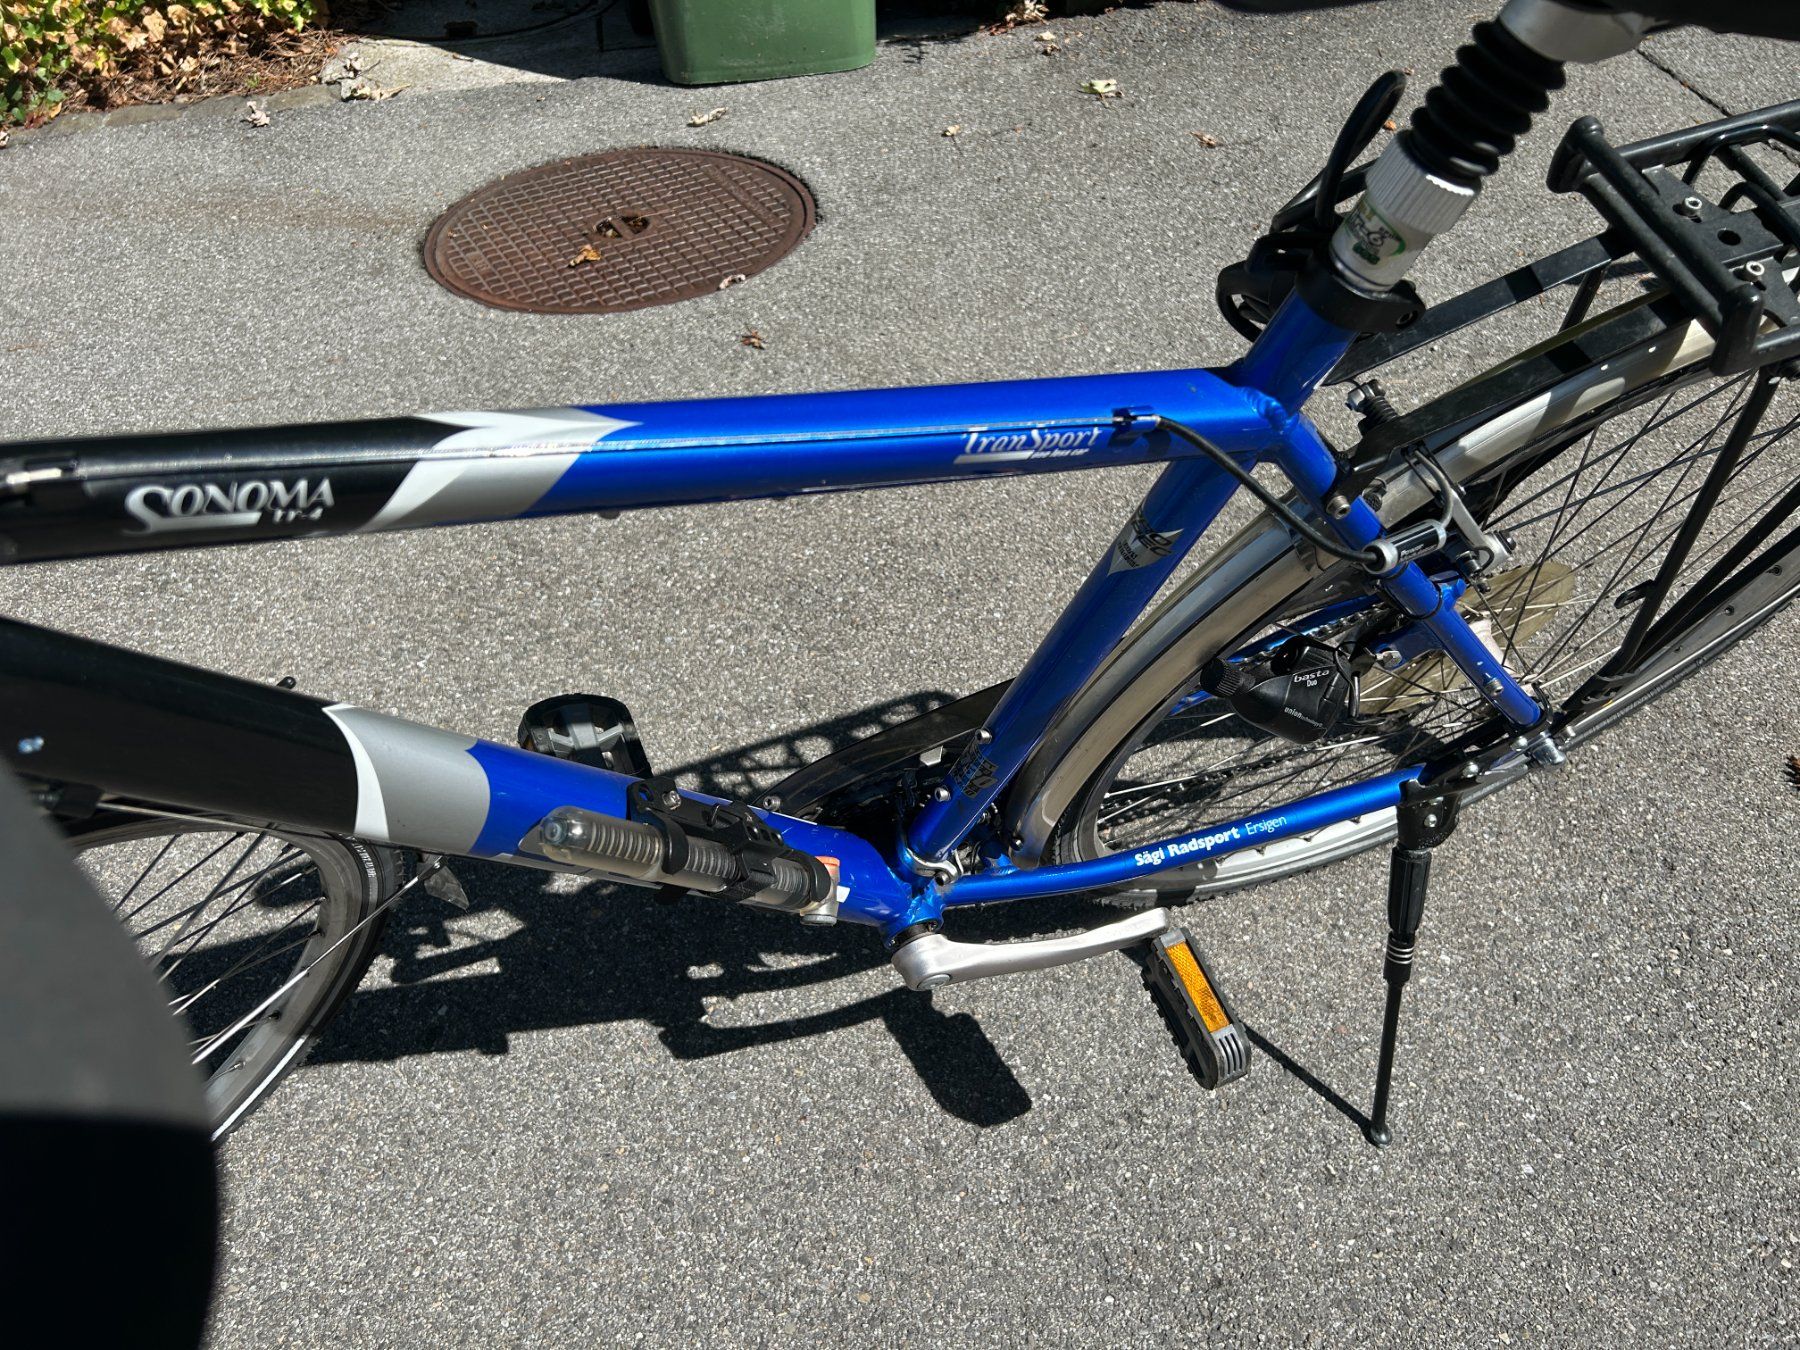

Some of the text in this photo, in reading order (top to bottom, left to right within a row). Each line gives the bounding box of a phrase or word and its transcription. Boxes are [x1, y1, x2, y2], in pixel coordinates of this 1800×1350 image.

[1293, 669, 1330, 683] basta
[1306, 679, 1318, 688] Duo
[1134, 816, 1288, 867] Sägi Radsport Ersigen
